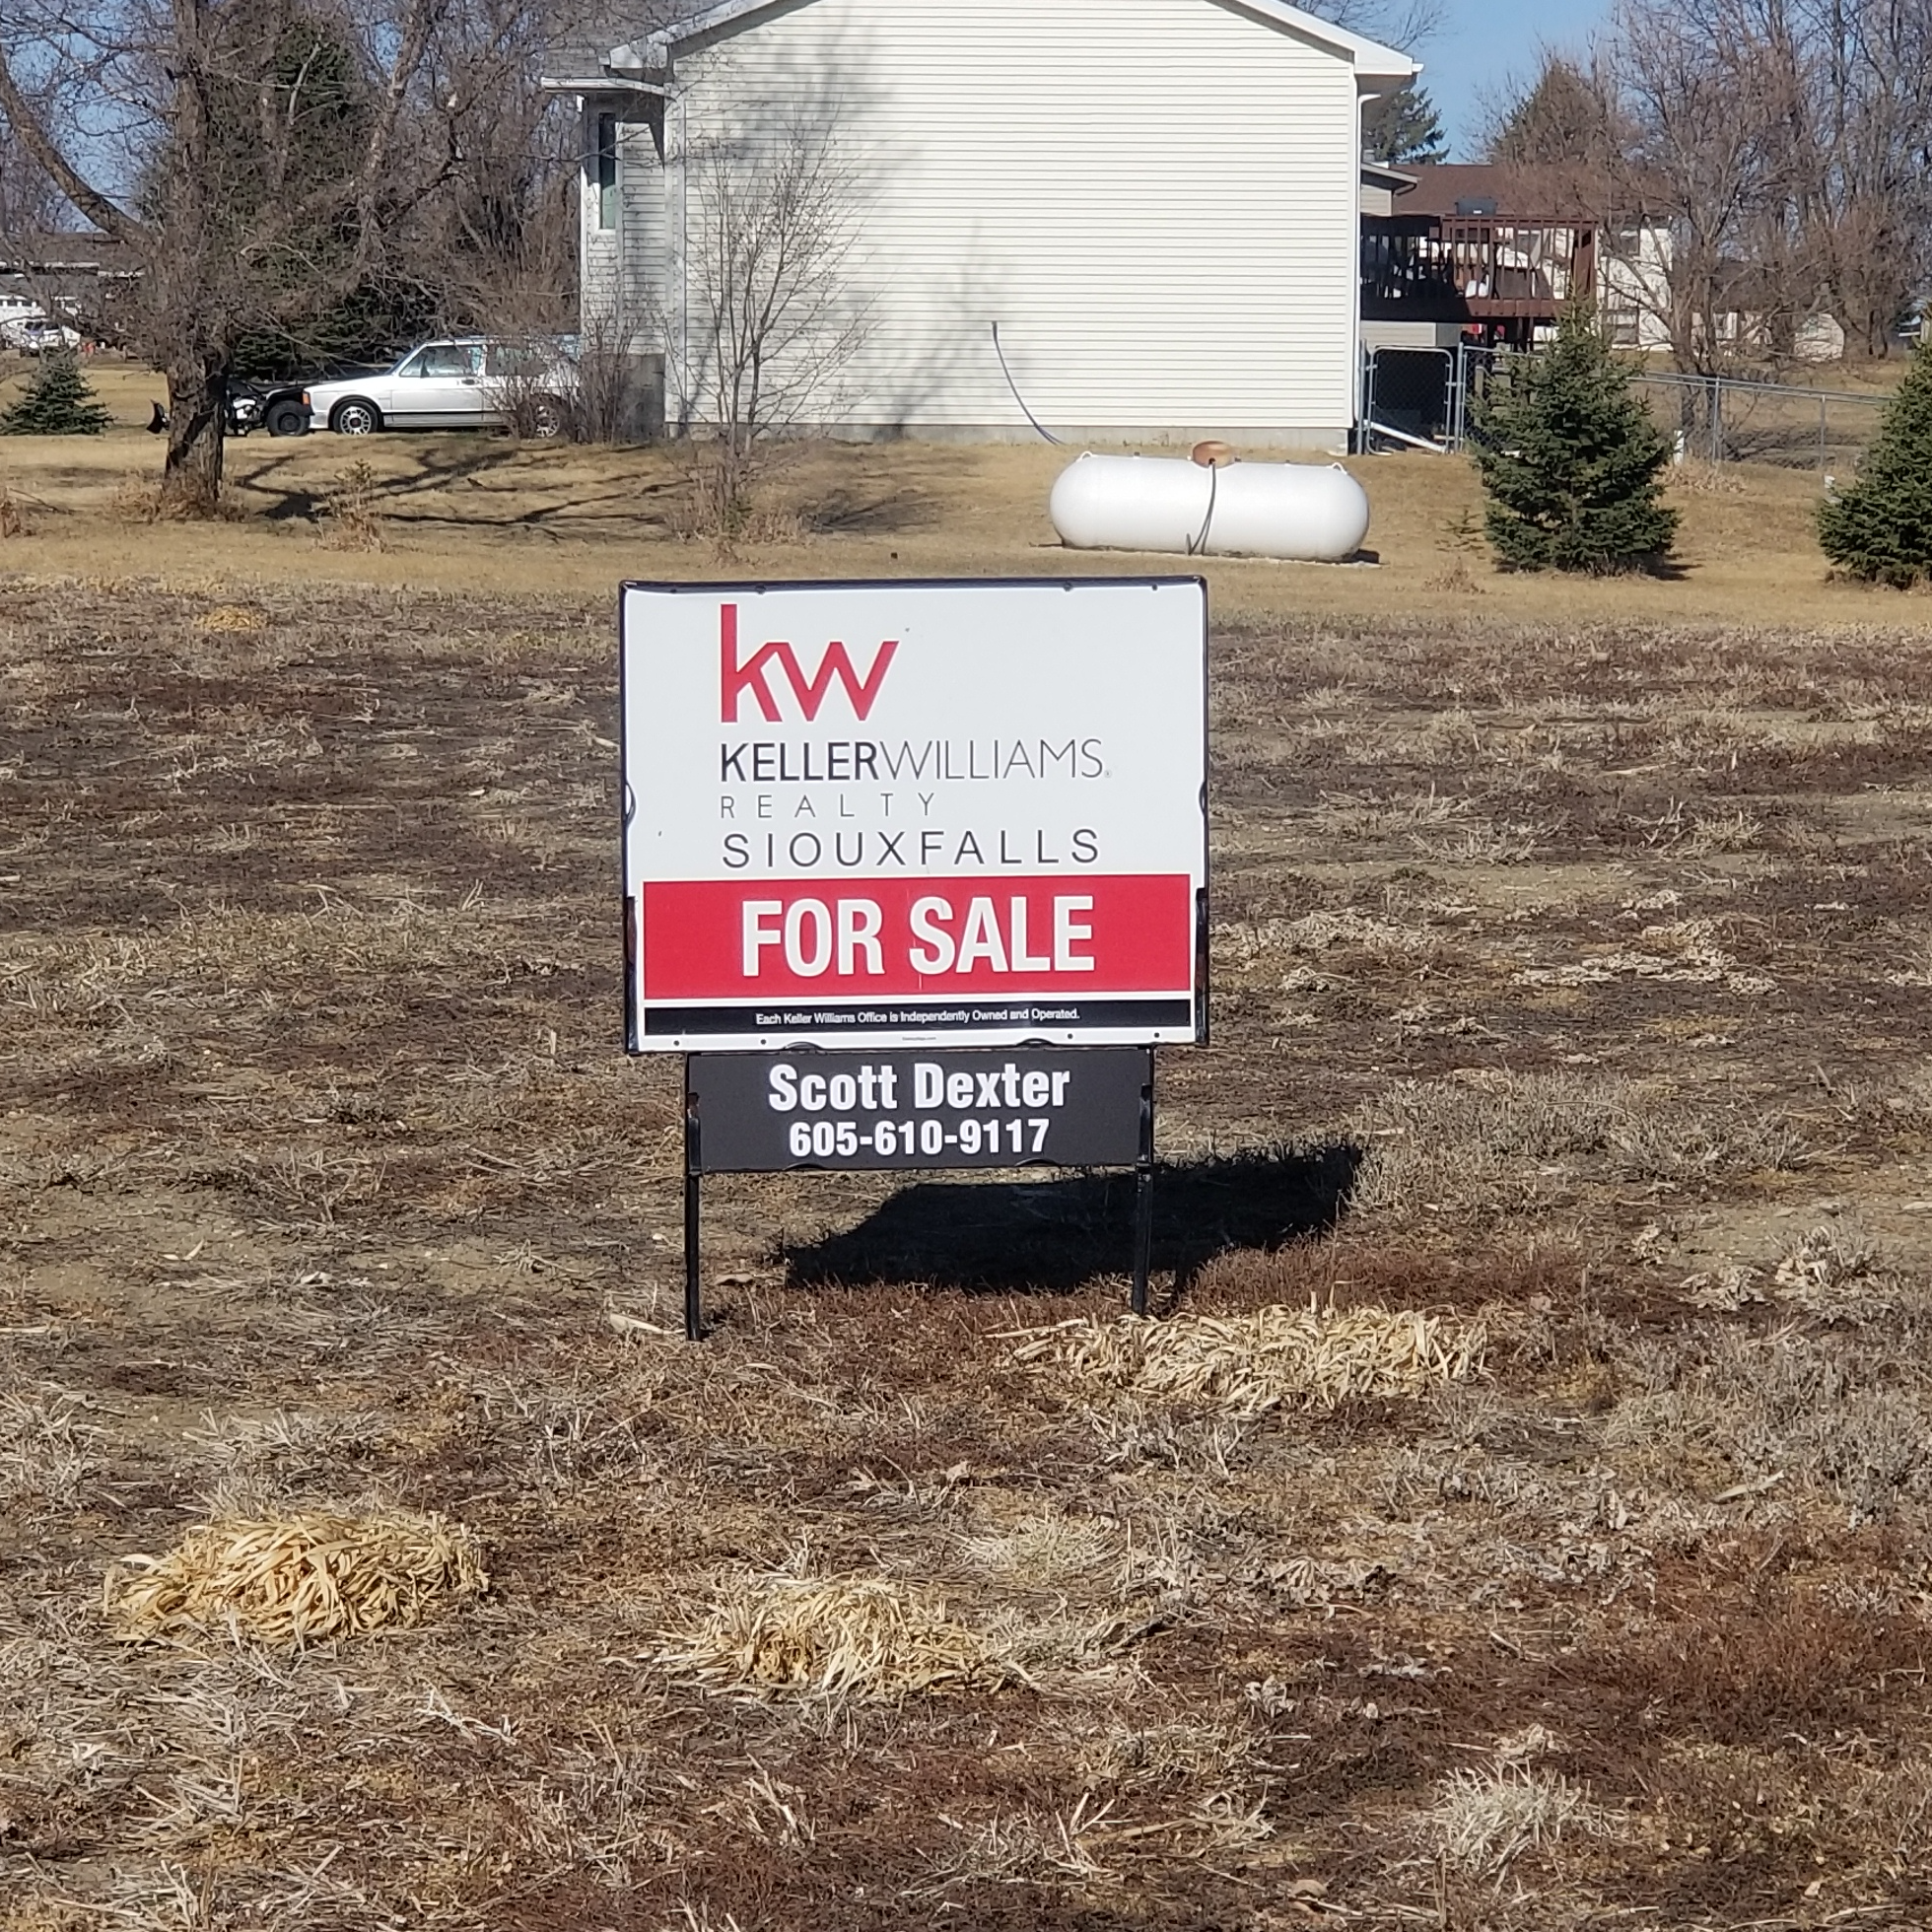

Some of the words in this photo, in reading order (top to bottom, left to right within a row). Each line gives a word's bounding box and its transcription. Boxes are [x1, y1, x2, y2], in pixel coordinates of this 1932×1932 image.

[721, 793, 935, 819] REALTY
[741, 898, 885, 978] FOR
[909, 895, 1096, 975] SALE
[756, 1013, 782, 1024] Each
[784, 1012, 812, 1024] Keller
[814, 1012, 856, 1023] Williams
[859, 1011, 887, 1023] Office
[889, 1011, 898, 1022] is
[900, 1010, 970, 1024] Independently
[973, 1009, 1007, 1021] Owned
[1009, 1008, 1028, 1020] and
[1031, 1008, 1079, 1021] Operated.
[768, 1065, 898, 1112] Scott
[915, 1063, 1070, 1109] Dexter
[790, 1118, 1050, 1157] 605-610-9117
